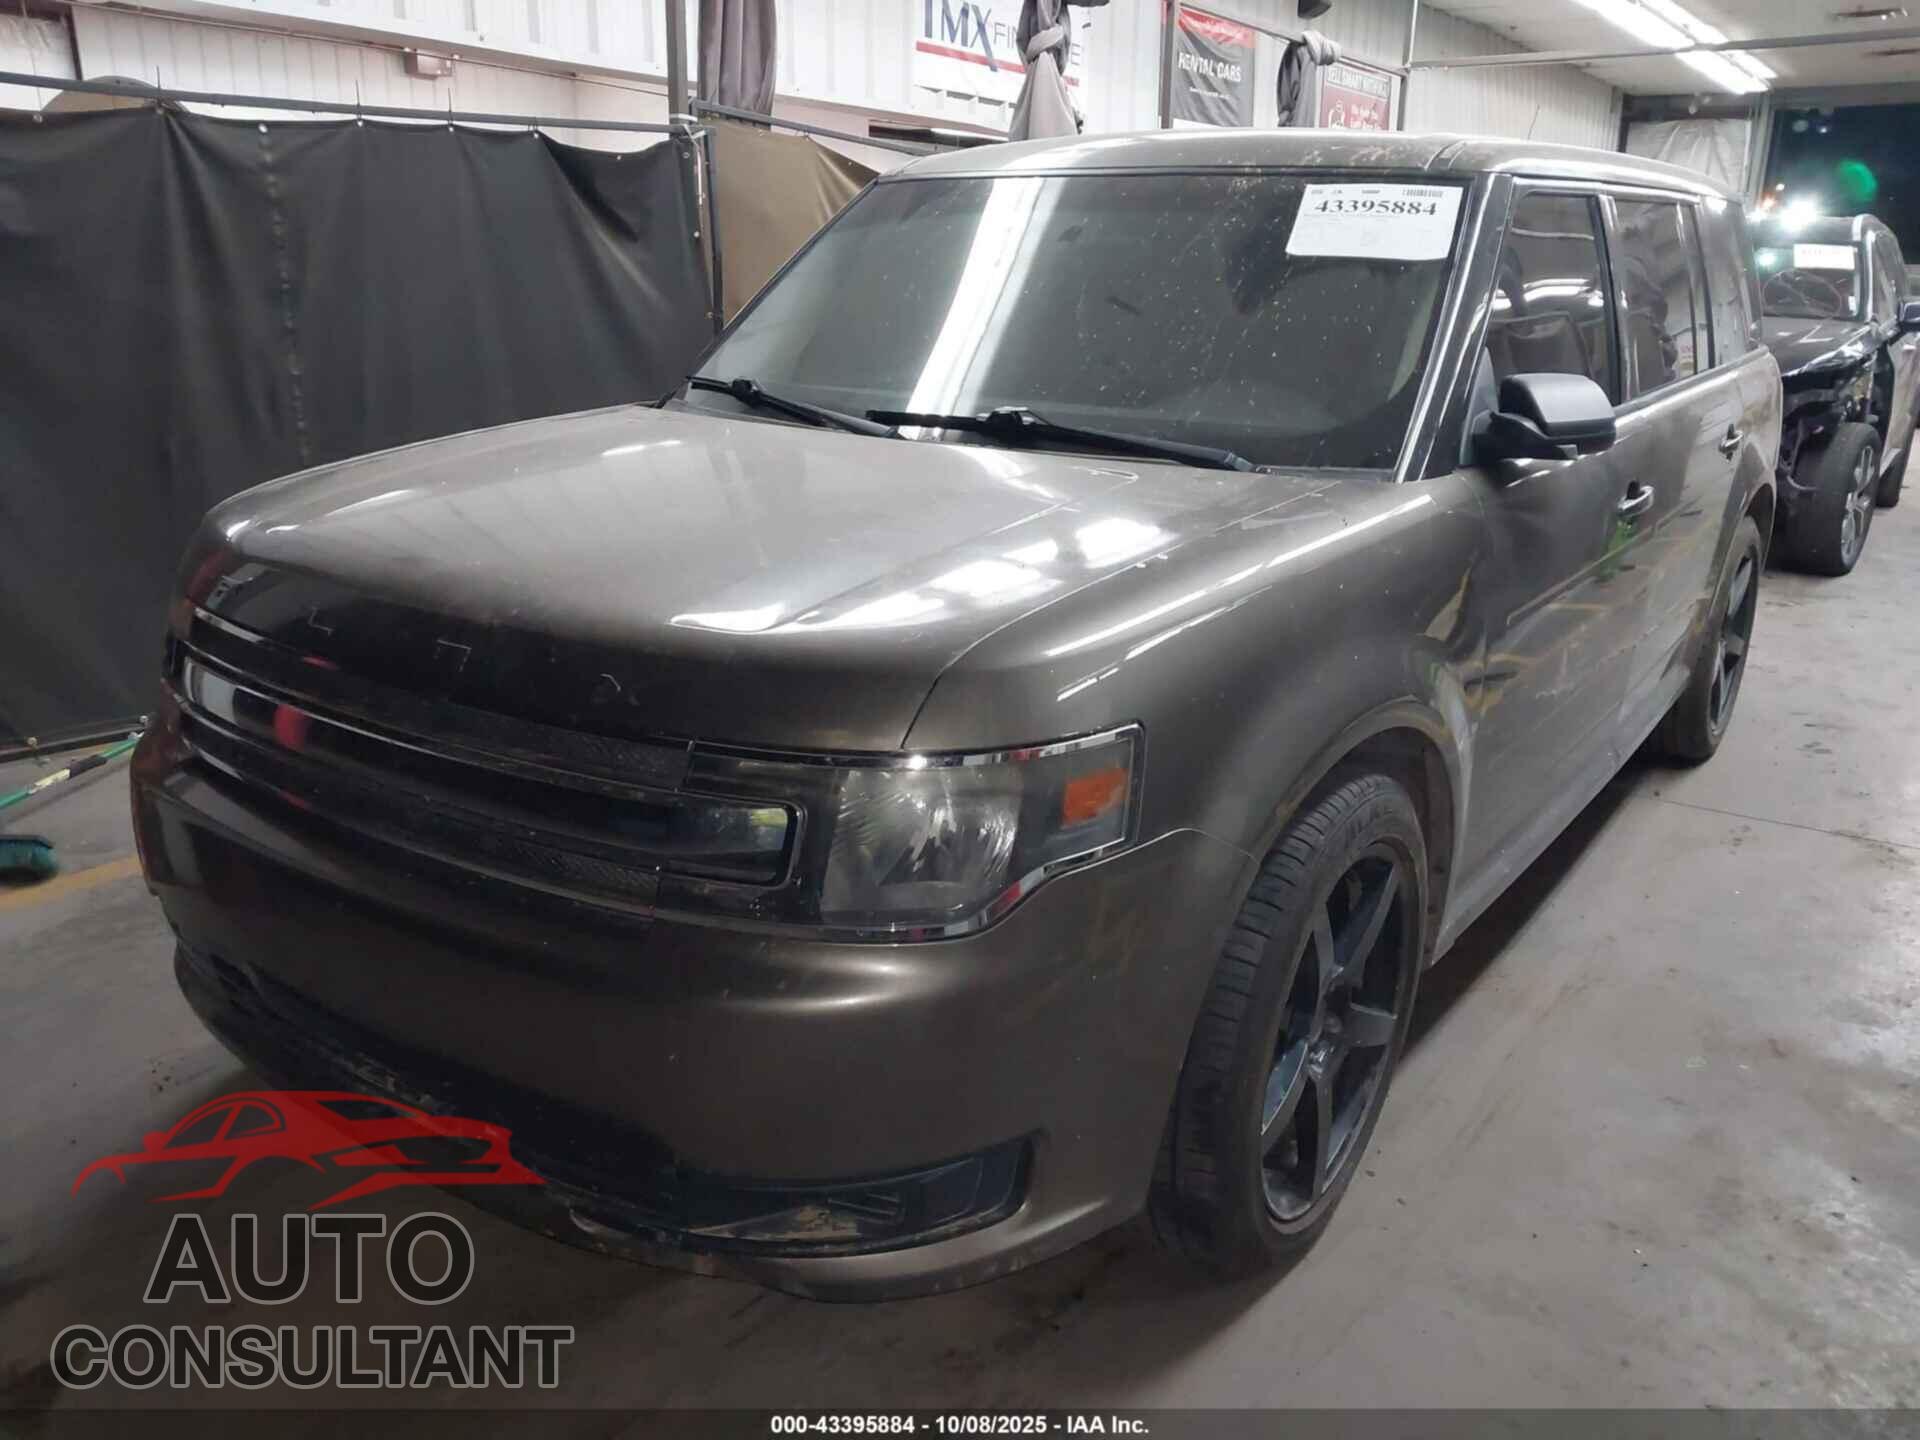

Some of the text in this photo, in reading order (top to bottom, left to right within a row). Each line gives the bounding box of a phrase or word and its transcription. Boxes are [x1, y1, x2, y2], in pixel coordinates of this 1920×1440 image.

[1178, 51, 1242, 83] RENTAL CARS
[1315, 199, 1437, 216] 43395884
